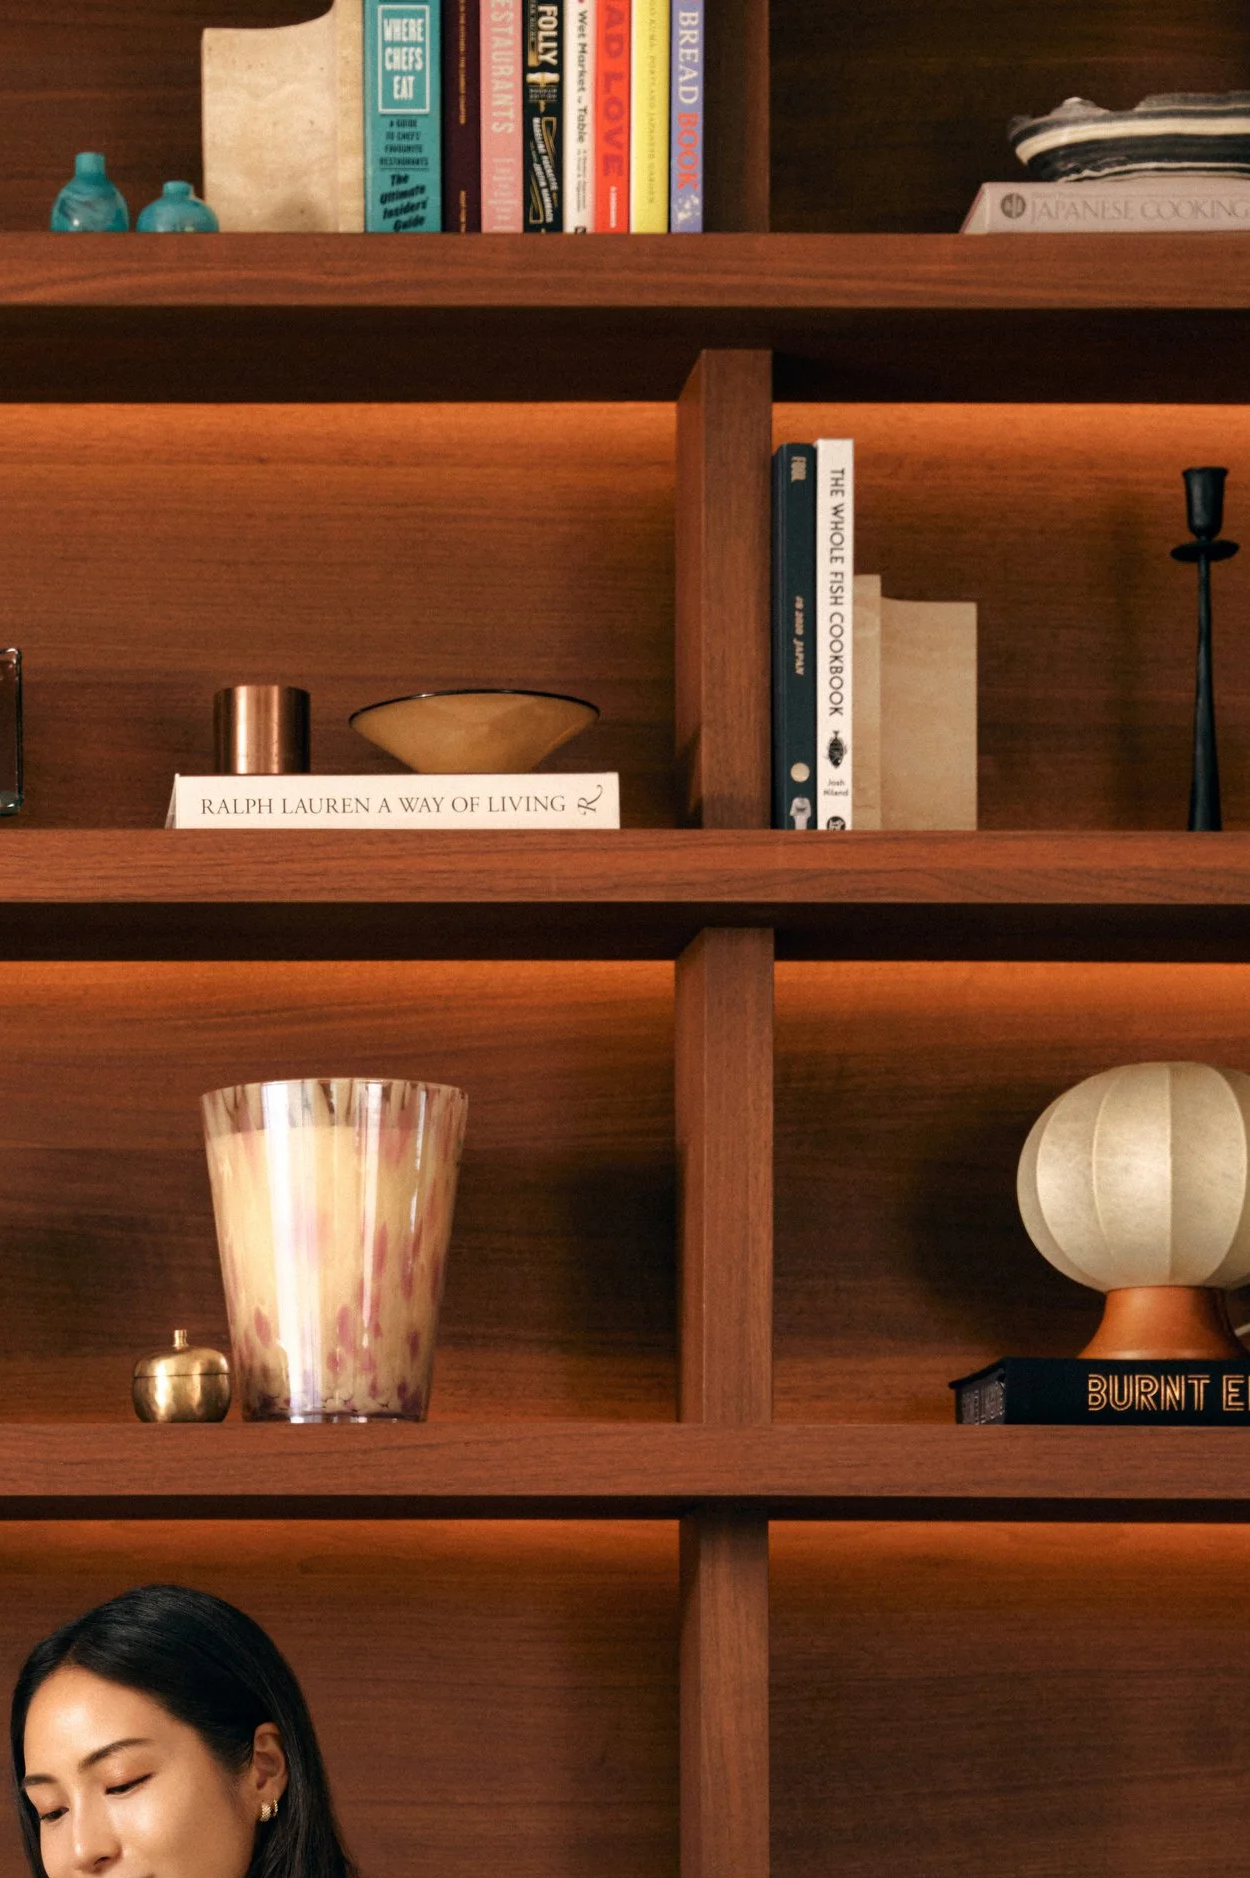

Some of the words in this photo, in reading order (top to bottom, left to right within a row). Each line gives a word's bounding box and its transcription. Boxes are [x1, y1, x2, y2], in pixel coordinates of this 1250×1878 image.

[383, 18, 424, 41] WHERE
[538, 5, 559, 66] FOLLY
[577, 10, 588, 38] Wet
[384, 47, 423, 71] CHEFS
[577, 42, 588, 92] Market
[678, 11, 699, 105] BREAD
[393, 75, 415, 99] EAT
[577, 105, 588, 144] Table
[603, 72, 625, 177] LOVE
[677, 112, 699, 192] BOOK
[380, 184, 426, 205] Ultimate
[391, 174, 409, 186] The
[393, 215, 425, 232] Guide
[1031, 199, 1135, 224] JAPANESE
[1140, 199, 1250, 220] COOKING
[829, 467, 845, 497] THE
[829, 503, 845, 563] WHOLE
[829, 571, 845, 606] FISH
[792, 638, 805, 675] JAPAN
[829, 611, 845, 717] COOKBOOK
[201, 798, 273, 815] RALPH
[282, 797, 371, 815] LAUREN
[378, 797, 393, 814] A
[398, 796, 445, 813] WAY
[451, 796, 480, 813] OF
[487, 795, 566, 813] LIVING
[823, 789, 849, 797] Niland
[1088, 1374, 1211, 1412] BURNT
[1222, 1374, 1250, 1412] E
